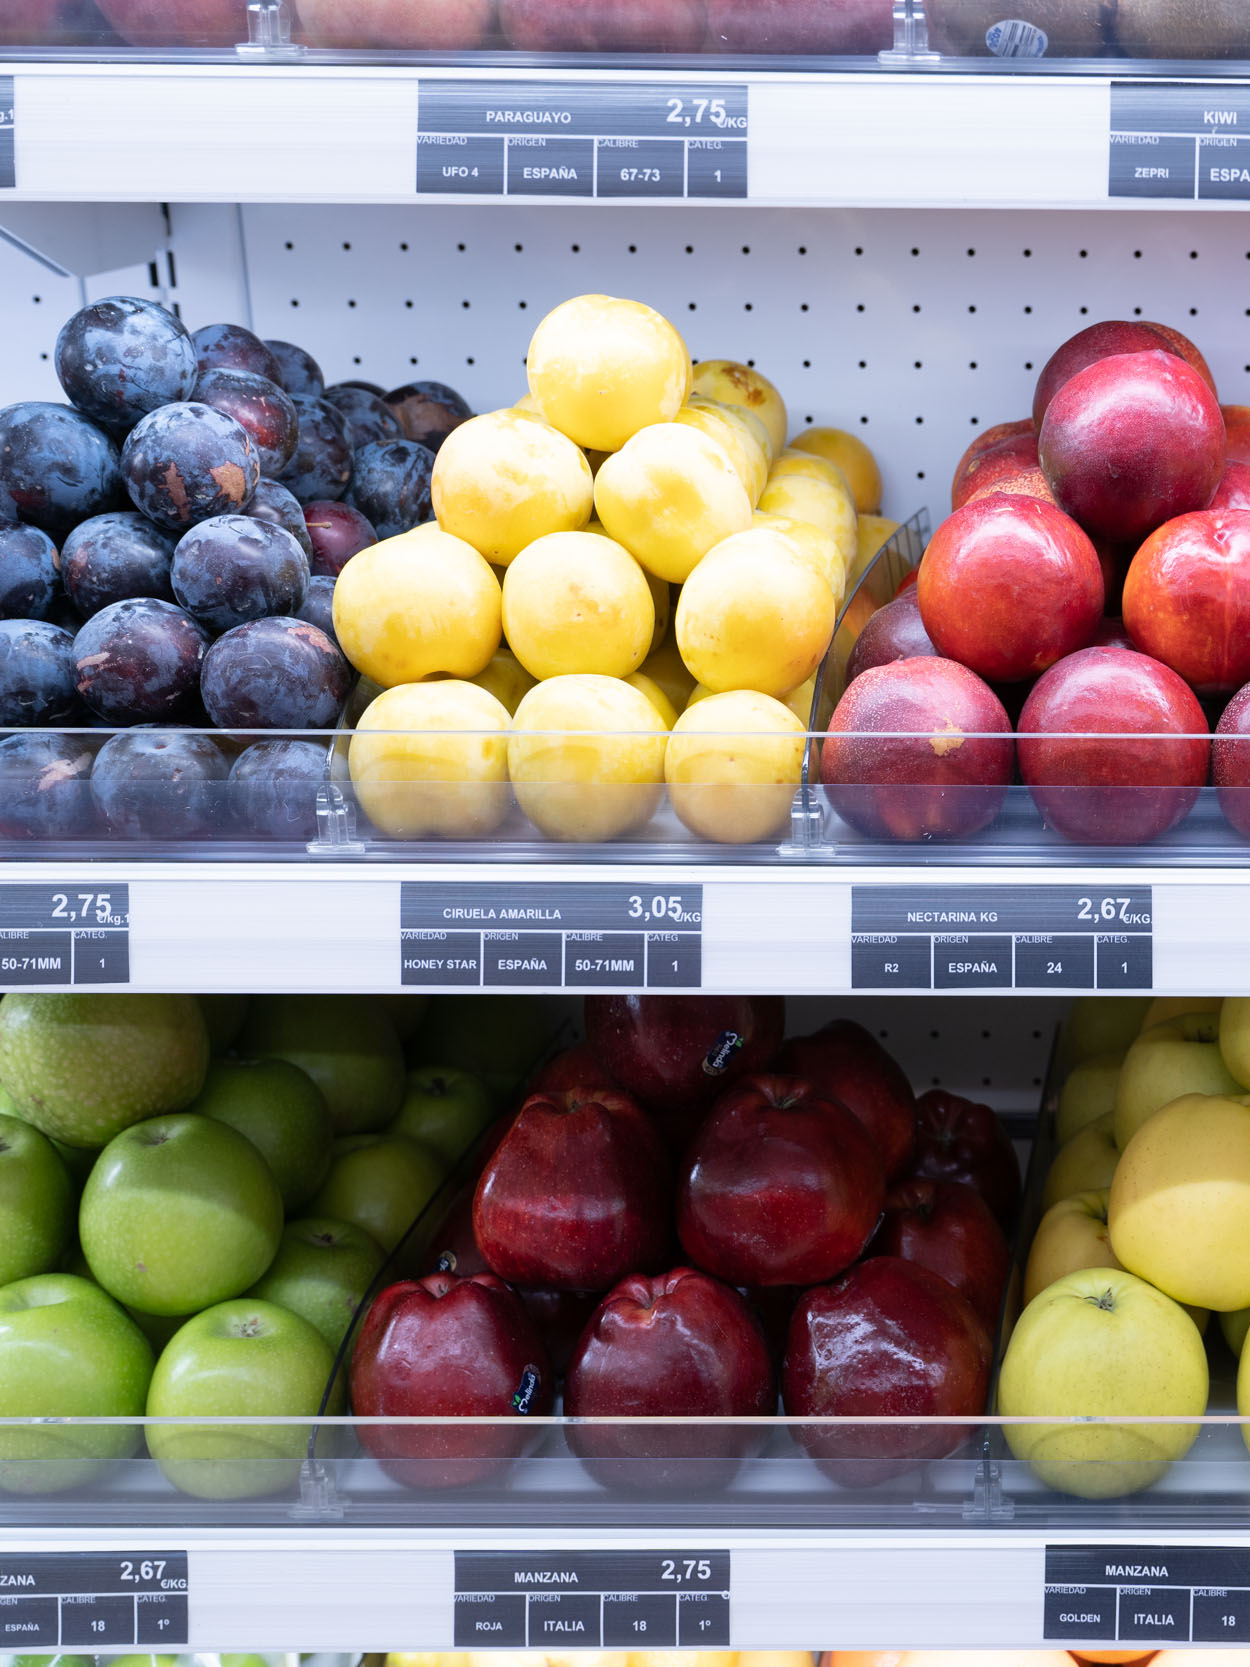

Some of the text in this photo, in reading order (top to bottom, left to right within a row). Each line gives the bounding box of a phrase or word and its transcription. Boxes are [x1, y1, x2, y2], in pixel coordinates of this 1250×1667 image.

[486, 111, 571, 124] PARAGUAYO
[667, 98, 726, 127] 2,75
[1204, 111, 1237, 125] KIWI
[417, 136, 467, 145] VARIEDAD
[506, 137, 546, 147] ORIGEN
[597, 138, 638, 148] CALIBRE
[1110, 135, 1159, 144] VARIEDAD
[1199, 138, 1237, 147] ORIGEN
[442, 166, 478, 177] UFO 4
[523, 166, 577, 179] ESPAÑA
[620, 169, 660, 182] 67-73
[714, 171, 721, 182] 1
[1135, 168, 1168, 179] ZEPRI
[51, 894, 112, 922] 2,75
[628, 896, 682, 921] 3,05
[1077, 898, 1131, 923] 2,67
[443, 908, 561, 920] CIRUELA AMARILLA
[907, 912, 998, 922] NECTARINA KG
[400, 932, 447, 940] VARIEDAD
[483, 932, 519, 941] ORIGEN
[564, 933, 603, 941] CALIBRE
[933, 936, 969, 944] ORIGEN
[1014, 936, 1053, 944] CALIBRE
[1, 958, 61, 969] 50-71MM
[100, 958, 104, 968] 1
[404, 959, 477, 970] HONEY STAR
[498, 958, 547, 971] ESPAÑA
[575, 960, 635, 972] 50-71MM
[671, 961, 678, 972] 1
[948, 961, 997, 973] ESPAÑA
[1121, 963, 1128, 973] 1
[884, 964, 899, 973] R2
[1047, 963, 1062, 974] 24
[120, 1560, 166, 1583] 2,67
[661, 1560, 711, 1584] 2,75
[1105, 1565, 1168, 1577] MANZANA
[514, 1572, 578, 1583] MANZANA
[1044, 1586, 1086, 1594] VARIEDAD
[1118, 1587, 1151, 1596] ORIGEN
[1192, 1589, 1227, 1597] CALIBRE
[60, 1596, 96, 1604] CALIBRE
[528, 1594, 560, 1602] ORIGEN
[603, 1594, 638, 1602] CALIBRE
[1059, 1614, 1100, 1623] GOLDEN
[1134, 1614, 1174, 1625] ITALIA
[1221, 1616, 1236, 1626] 18
[5, 1622, 40, 1632] ESPAÑA
[91, 1620, 105, 1632] 18
[476, 1622, 502, 1631] ROJA
[544, 1621, 584, 1631] ITALIA
[633, 1621, 647, 1631] 18
